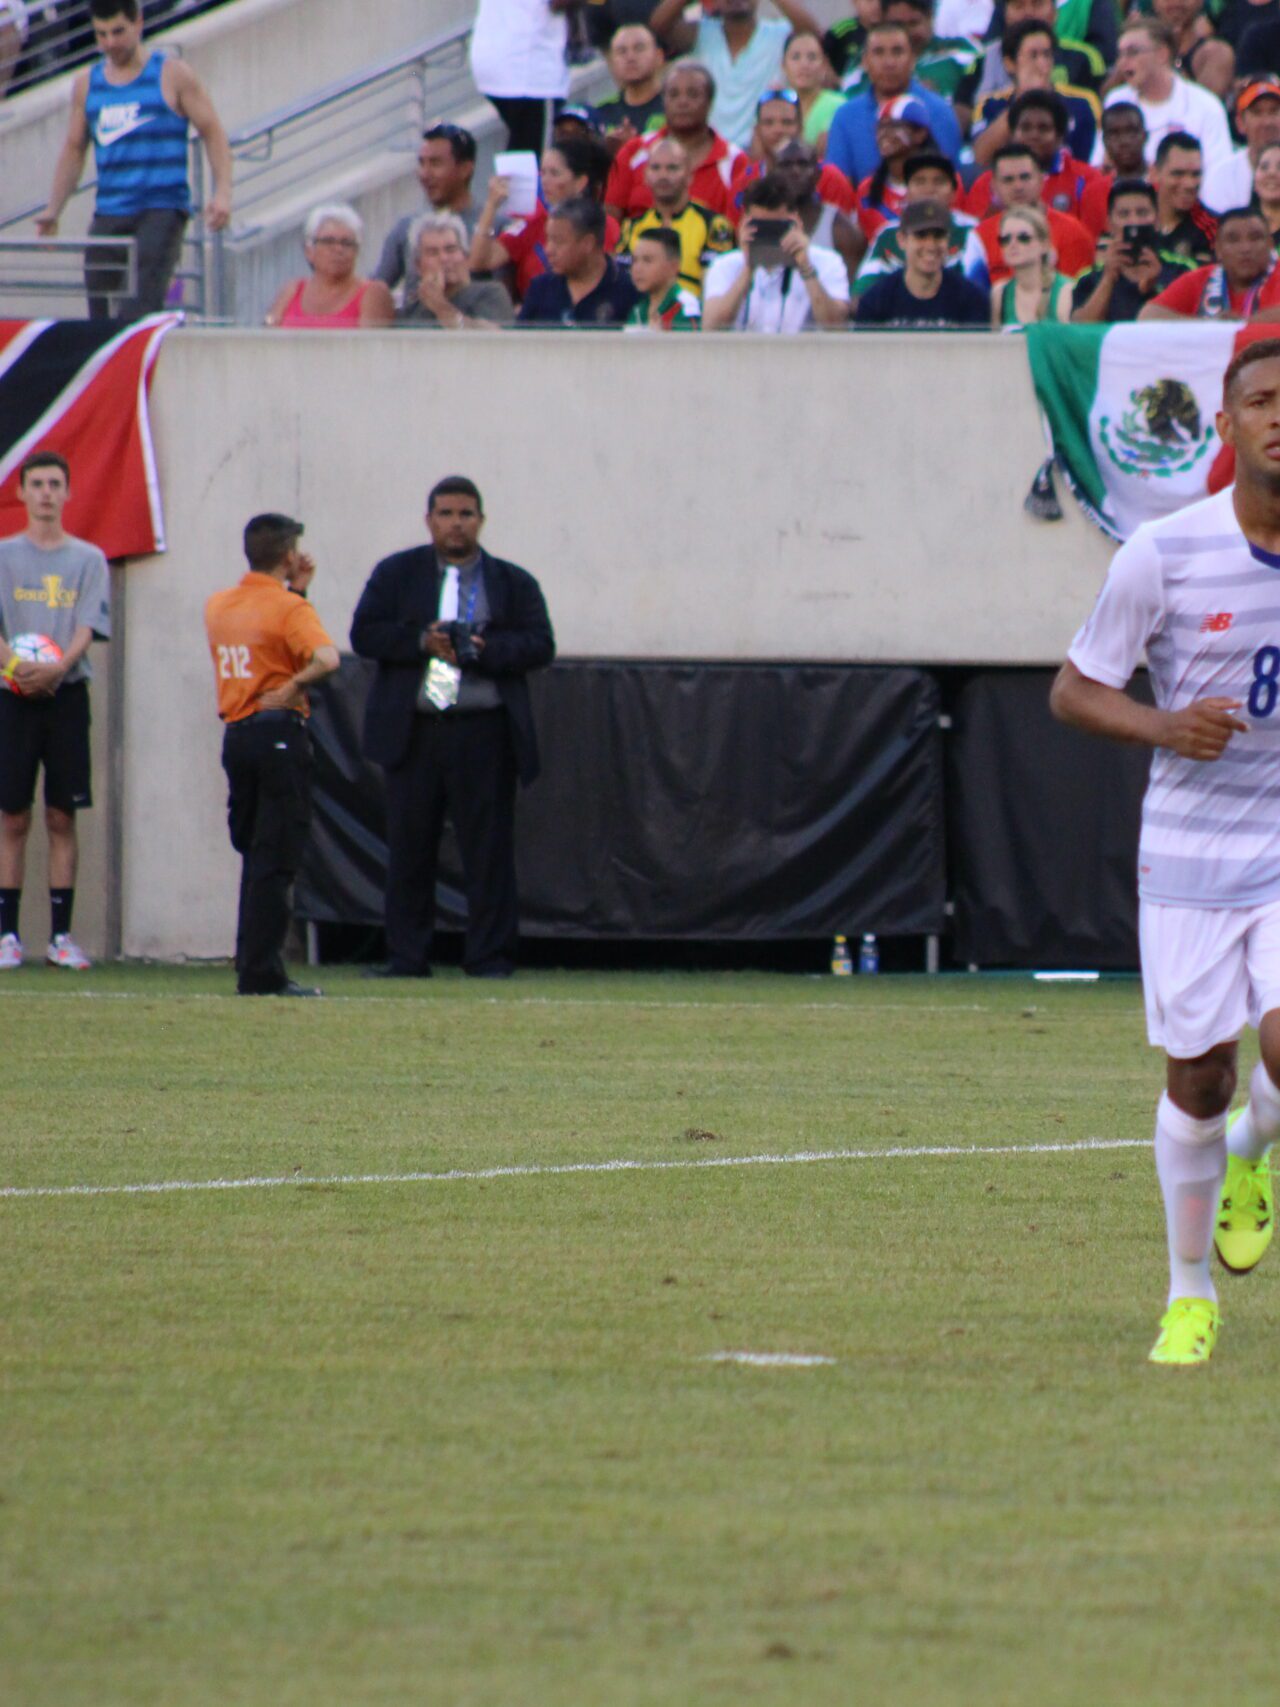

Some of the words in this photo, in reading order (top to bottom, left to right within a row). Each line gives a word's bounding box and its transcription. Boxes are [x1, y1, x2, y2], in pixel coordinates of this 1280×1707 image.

[100, 101, 141, 131] NIKE
[14, 588, 48, 602] GOLD
[216, 644, 252, 679] 212
